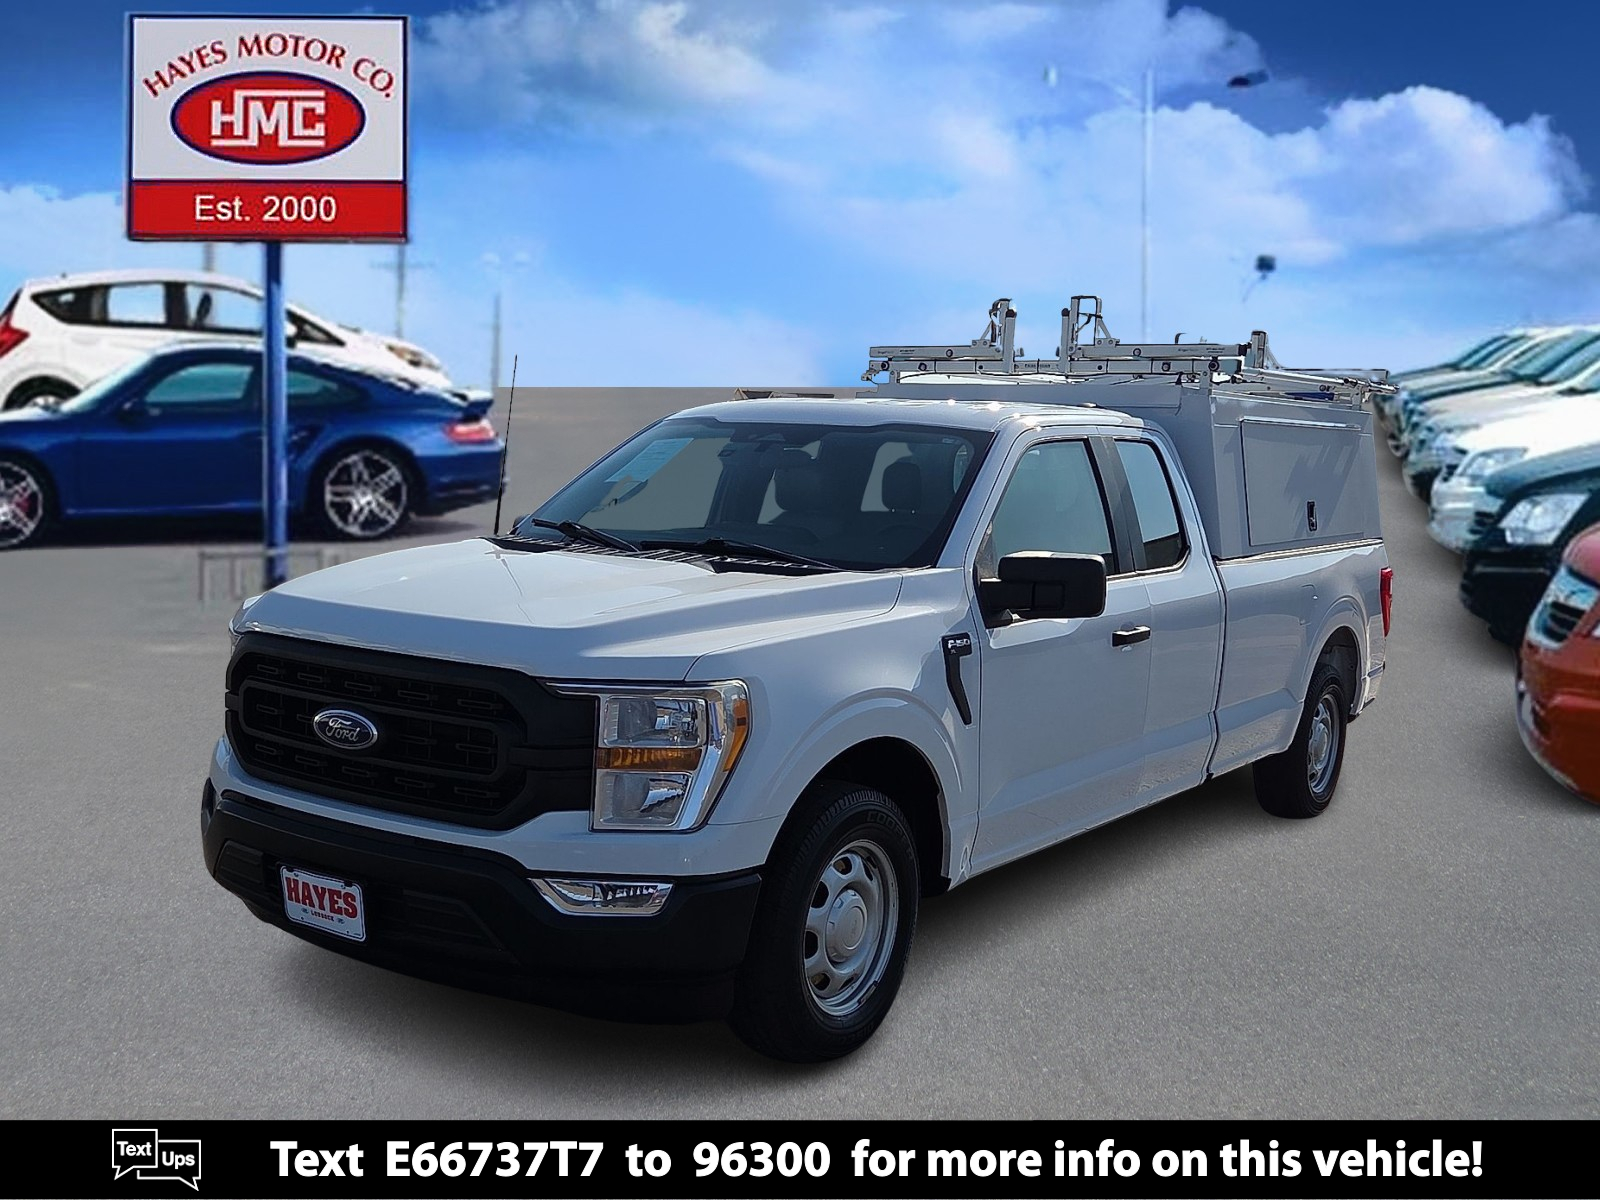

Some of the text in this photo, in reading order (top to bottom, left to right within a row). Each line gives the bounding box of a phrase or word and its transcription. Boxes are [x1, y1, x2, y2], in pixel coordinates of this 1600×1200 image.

[143, 32, 395, 98] HAYES MOTOR CO.
[210, 88, 326, 147] HMC
[194, 194, 337, 222] Est. 2000
[325, 717, 361, 742] Ford
[285, 876, 358, 919] HAYES
